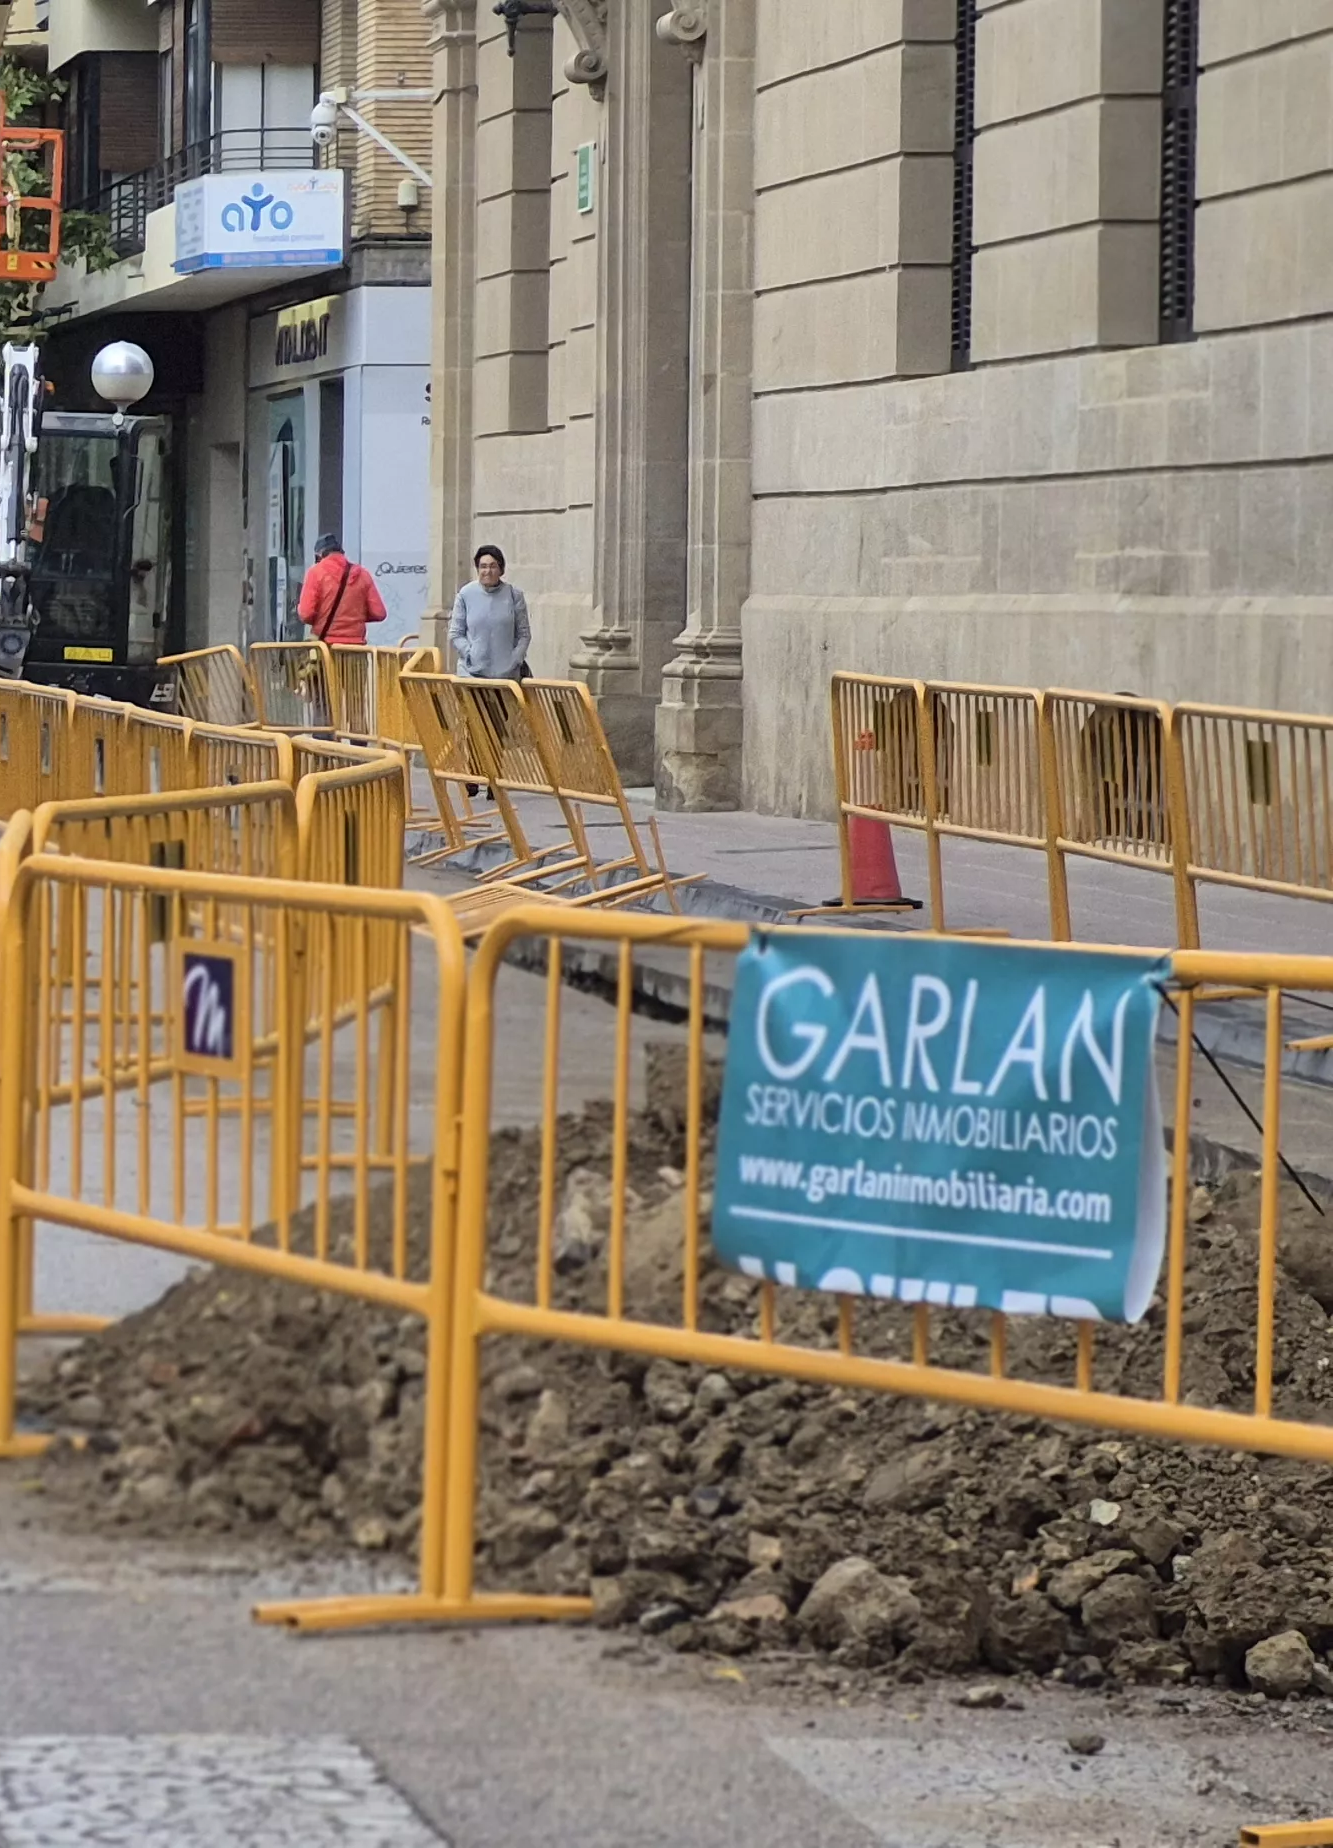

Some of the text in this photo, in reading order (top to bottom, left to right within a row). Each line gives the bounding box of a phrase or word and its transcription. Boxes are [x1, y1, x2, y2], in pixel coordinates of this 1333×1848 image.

[375, 561, 428, 577] ¿Quieres
[757, 965, 1132, 1106] GARLAN
[745, 1083, 1119, 1160] SERVICIOS INMOBILIARIOS
[739, 1153, 1112, 1222] www.garlaninmobiliaria.com
